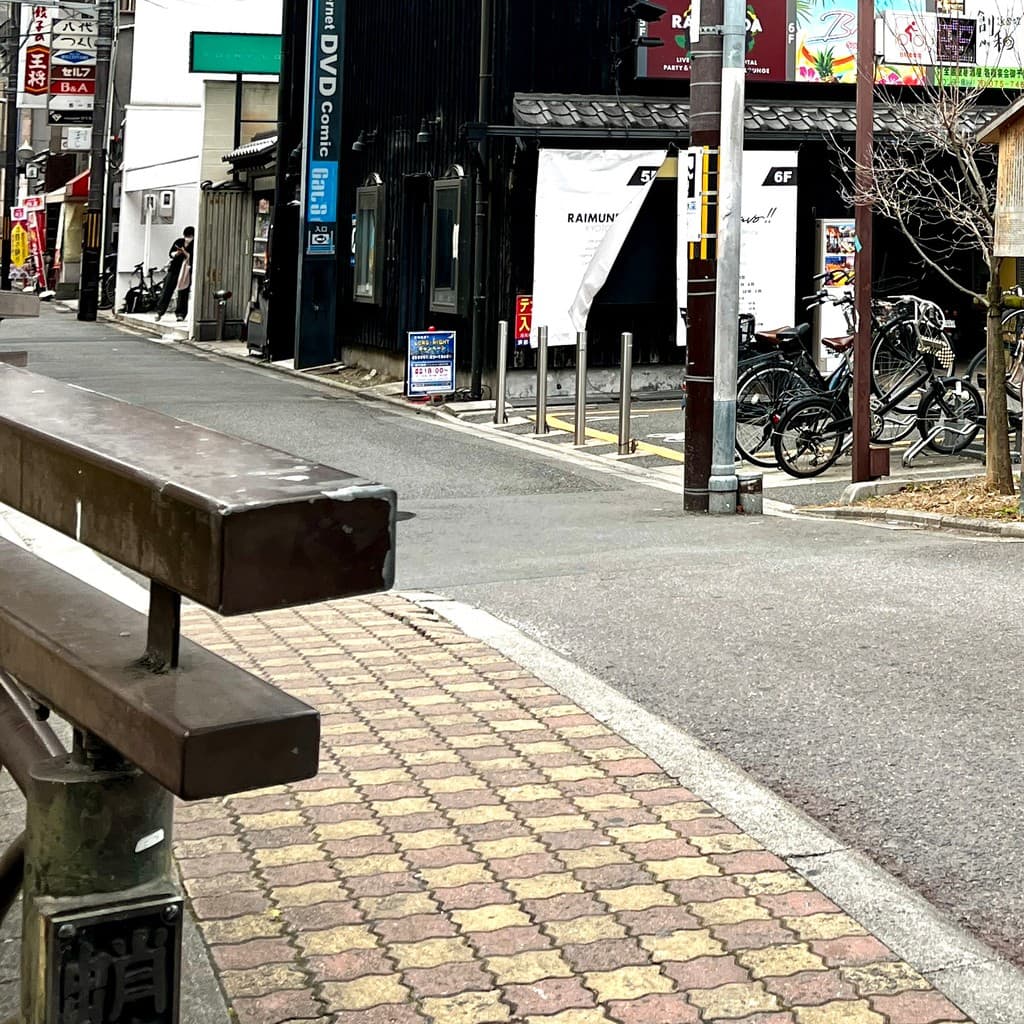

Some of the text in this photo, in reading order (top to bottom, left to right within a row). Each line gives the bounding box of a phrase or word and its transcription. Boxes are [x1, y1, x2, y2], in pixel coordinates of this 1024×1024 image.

[787, 22, 796, 44] 6F
[319, 34, 338, 97] DVD
[319, 101, 333, 157] Comic
[774, 171, 792, 183] 6F
